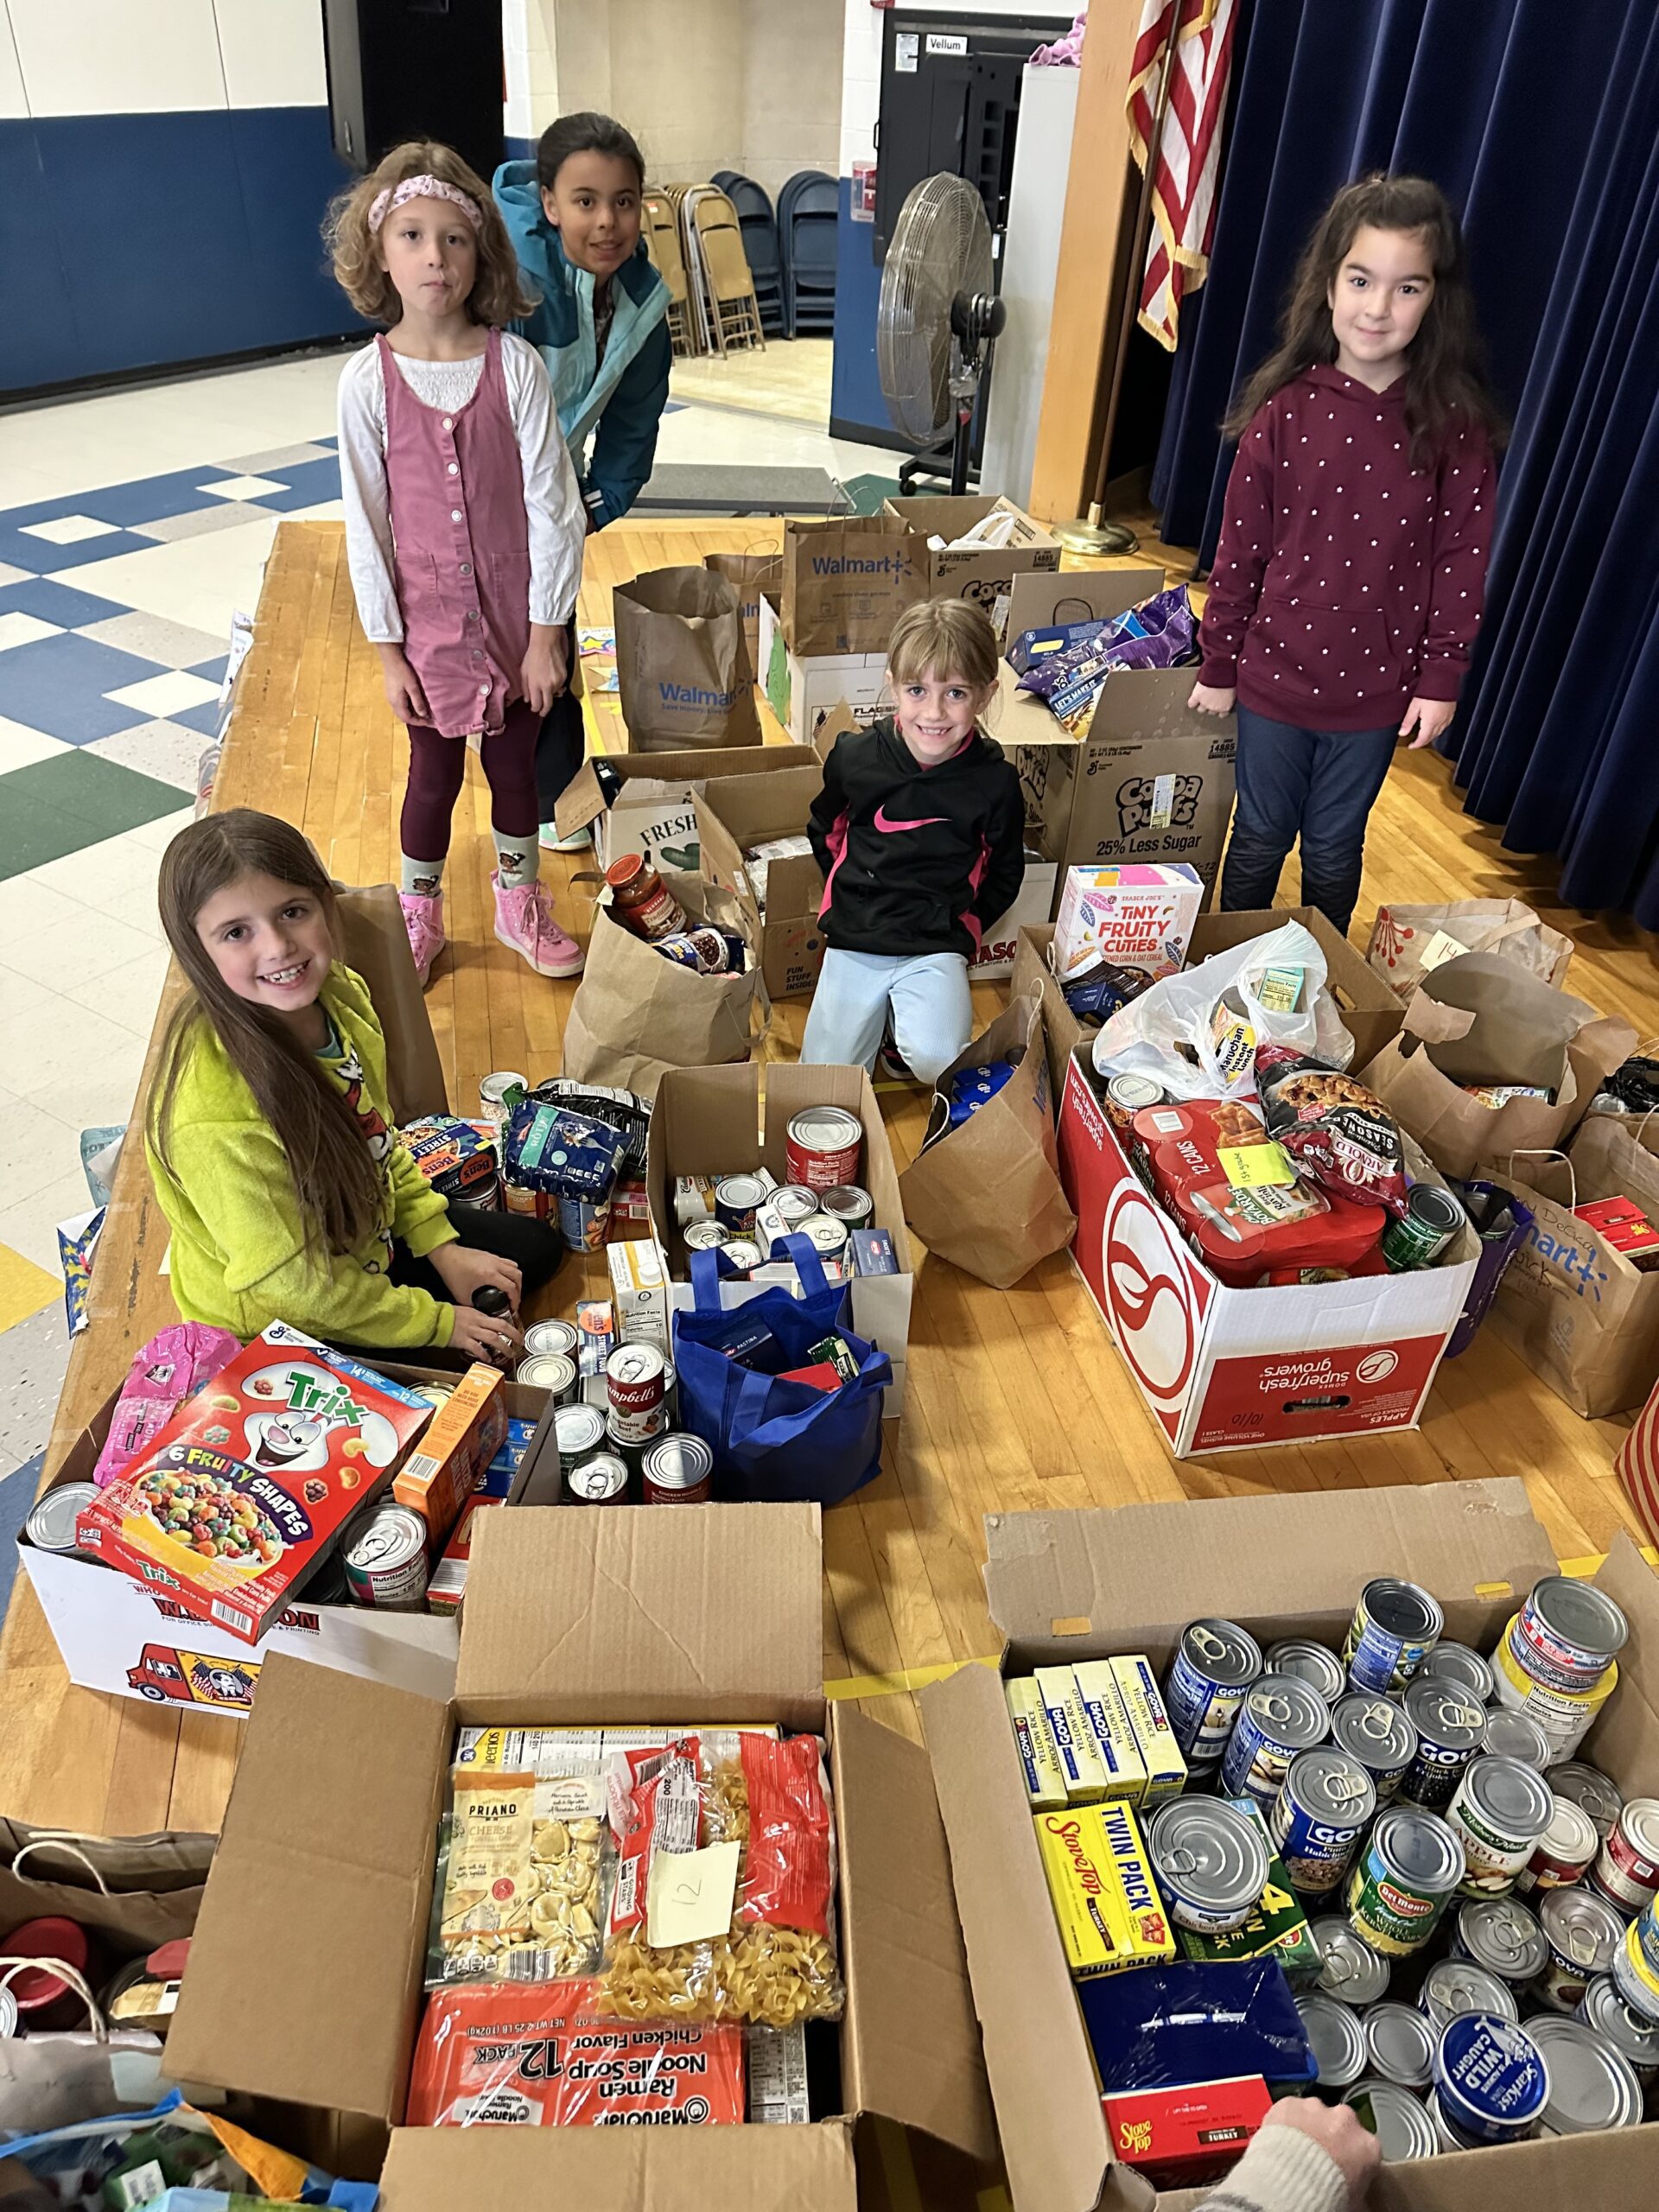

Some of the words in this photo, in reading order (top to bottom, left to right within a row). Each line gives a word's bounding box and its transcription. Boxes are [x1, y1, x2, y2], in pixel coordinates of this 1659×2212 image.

[931, 39, 961, 50] Vellum
[961, 580, 1013, 607] Coco
[659, 682, 736, 707] Walmar
[1054, 693, 1074, 710] LET'S
[1072, 683, 1091, 702] MAKE
[1210, 743, 1236, 753] 14885
[639, 813, 698, 847] FRESH
[1096, 839, 1126, 856] 25%
[1129, 837, 1159, 854] Less
[1162, 835, 1202, 852] Sugar
[1437, 942, 1459, 961] 14
[785, 972, 812, 983] STUFF
[787, 966, 804, 976] FUN
[1220, 1027, 1245, 1072] Maruchan
[1229, 1042, 1249, 1072] Instant
[1237, 1047, 1255, 1071] Lunch
[417, 1135, 452, 1156] STREET
[1176, 1140, 1205, 1166] CANS
[1337, 1141, 1385, 1174] ARNOLD
[422, 1156, 455, 1175] Ben's
[463, 1160, 491, 1179] Ben's
[1192, 1164, 1211, 1176] 12
[597, 1334, 607, 1354] STREET
[736, 1335, 758, 1350] PASTINA
[1263, 1357, 1332, 1377] growers
[1259, 1371, 1351, 1393] superfresh
[286, 1369, 370, 1427] Trix
[399, 1390, 410, 1402] 12
[1370, 1412, 1408, 1424] APPLES
[168, 1445, 185, 1462] 6
[250, 1478, 308, 1535] SHAPES
[137, 1560, 181, 1592] Trix
[372, 1569, 408, 1583] Nutrition
[162, 1615, 176, 1624] FOR
[177, 1618, 202, 1627] OFFICE
[285, 1626, 321, 1636] PRINTING
[1102, 1693, 1114, 1712] RICE
[1109, 1682, 1129, 1726] AMARILLO
[1147, 1691, 1164, 1719] GOYA
[1533, 1685, 1567, 1706] Nutrition
[1027, 1710, 1039, 1731] RICE
[1064, 1699, 1076, 1718] RICE
[1071, 1688, 1091, 1732] AMARILLO
[1090, 1702, 1111, 1738] GOYA
[1132, 1687, 1150, 1722] YELLOW
[1145, 1719, 1157, 1739] RICE
[1526, 1701, 1553, 1718] Calories
[1036, 1700, 1052, 1745] AMARILLO
[1052, 1708, 1072, 1745] GOYA
[1107, 1712, 1123, 1745] YELLOW
[1128, 1707, 1150, 1751] AMARILLO
[1018, 1731, 1032, 1758] GOYA
[1070, 1718, 1085, 1752] YELLOW
[1086, 1731, 1101, 1760] ARROZ
[1123, 1726, 1139, 1754] ARROZ
[1034, 1732, 1048, 1764] YELLOW
[1047, 1744, 1062, 1775] ARROZ
[663, 1778, 672, 1796] 200
[469, 1803, 518, 1815] PRIANO
[469, 1825, 513, 1836] CHEESE
[1100, 1805, 1137, 1857] TWIN
[1451, 1827, 1510, 1866] APPLE
[620, 1880, 630, 1904] STARS
[626, 1879, 635, 1911] GUIDING
[1117, 1860, 1154, 1912] PACK
[1381, 1886, 1398, 1903] Del
[1396, 1896, 1430, 1912] Monte
[1090, 1907, 1107, 1934] TURKEY
[1179, 1914, 1216, 1932] Chicken
[1078, 1962, 1122, 1977] TWIN
[1126, 1953, 1167, 1968] PACK
[502, 2024, 513, 2033] LB
[550, 2018, 565, 2028] NET
[573, 2032, 628, 2050] Flavor
[632, 2031, 702, 2047] Chicken
[474, 2043, 518, 2065] PACK
[519, 2037, 565, 2081] 12
[628, 2053, 709, 2075] Noodle
[1452, 2033, 1491, 2081] CAUGHT
[569, 2059, 626, 2081] Soup
[1465, 2047, 1503, 2089] WILD
[599, 2077, 676, 2100] Ramen
[1497, 2063, 1539, 2112] StarKist
[1120, 2120, 1154, 2150] Stove
[1134, 2133, 1153, 2155] Top
[1208, 2131, 1239, 2143] TURKEY
